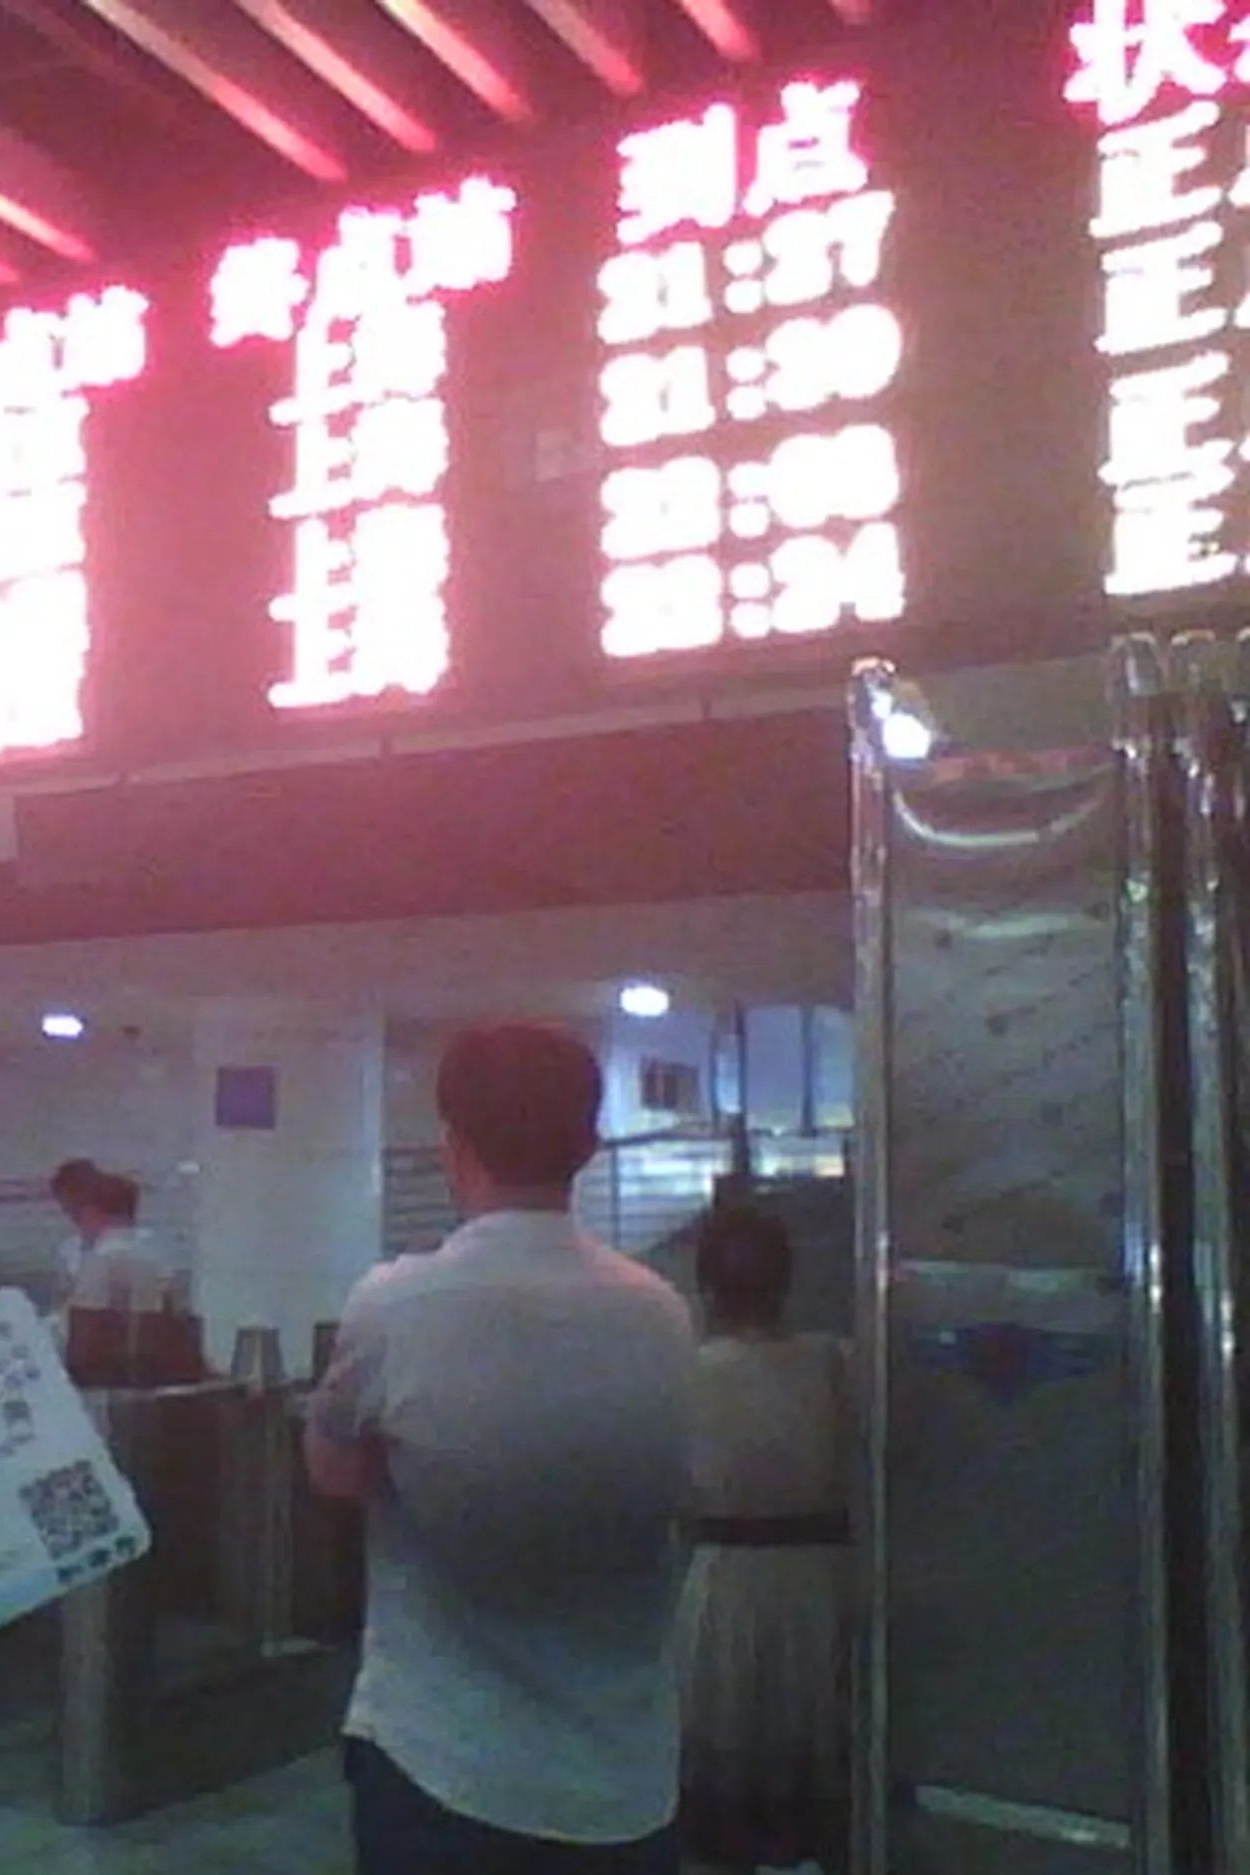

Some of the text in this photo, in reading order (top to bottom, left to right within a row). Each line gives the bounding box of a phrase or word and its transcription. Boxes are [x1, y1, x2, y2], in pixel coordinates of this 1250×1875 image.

[1088, 99, 1250, 238] 正
[1093, 220, 1250, 354] 正
[1096, 350, 1250, 486] 正
[1103, 461, 1250, 597] 正
